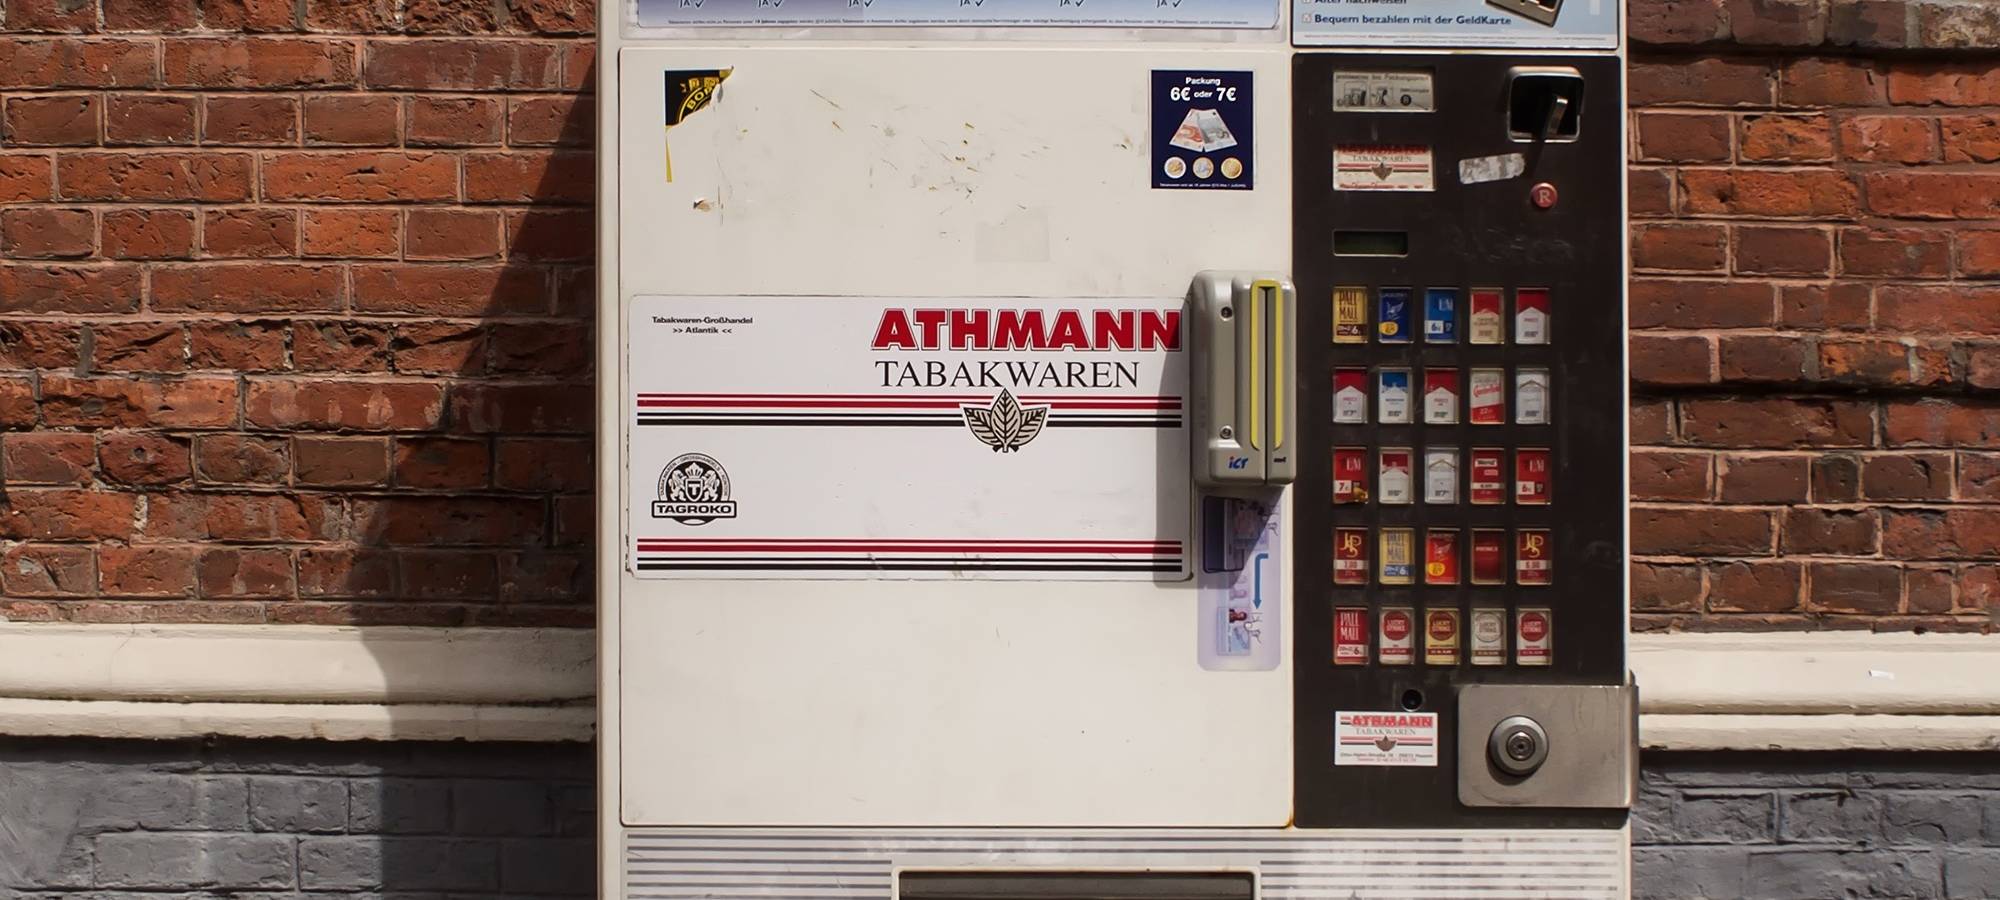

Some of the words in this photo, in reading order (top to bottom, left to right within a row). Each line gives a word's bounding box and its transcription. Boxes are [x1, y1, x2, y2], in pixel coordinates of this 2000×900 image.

[1314, 14, 1359, 25] Bequem
[1362, 14, 1410, 24] bezahlen
[1413, 15, 1431, 24] mit
[1434, 15, 1452, 24] der
[1456, 15, 1512, 25] GeldKarte
[1185, 76, 1221, 86] Packung
[1170, 86, 1191, 101] 6€
[1193, 90, 1213, 98] oder
[1216, 86, 1237, 101] 7€
[1538, 190, 1551, 204] R
[652, 316, 754, 325] Tabakwaren-Großhandel
[685, 326, 719, 335] Atlantik
[871, 308, 1183, 351] ATHMANN
[875, 360, 1140, 389] TABAKWAREN
[656, 504, 732, 514] TAGROKO
[1340, 611, 1359, 626] PALL
[1340, 626, 1359, 641] MALL
[1352, 715, 1433, 727] ATHMANN
